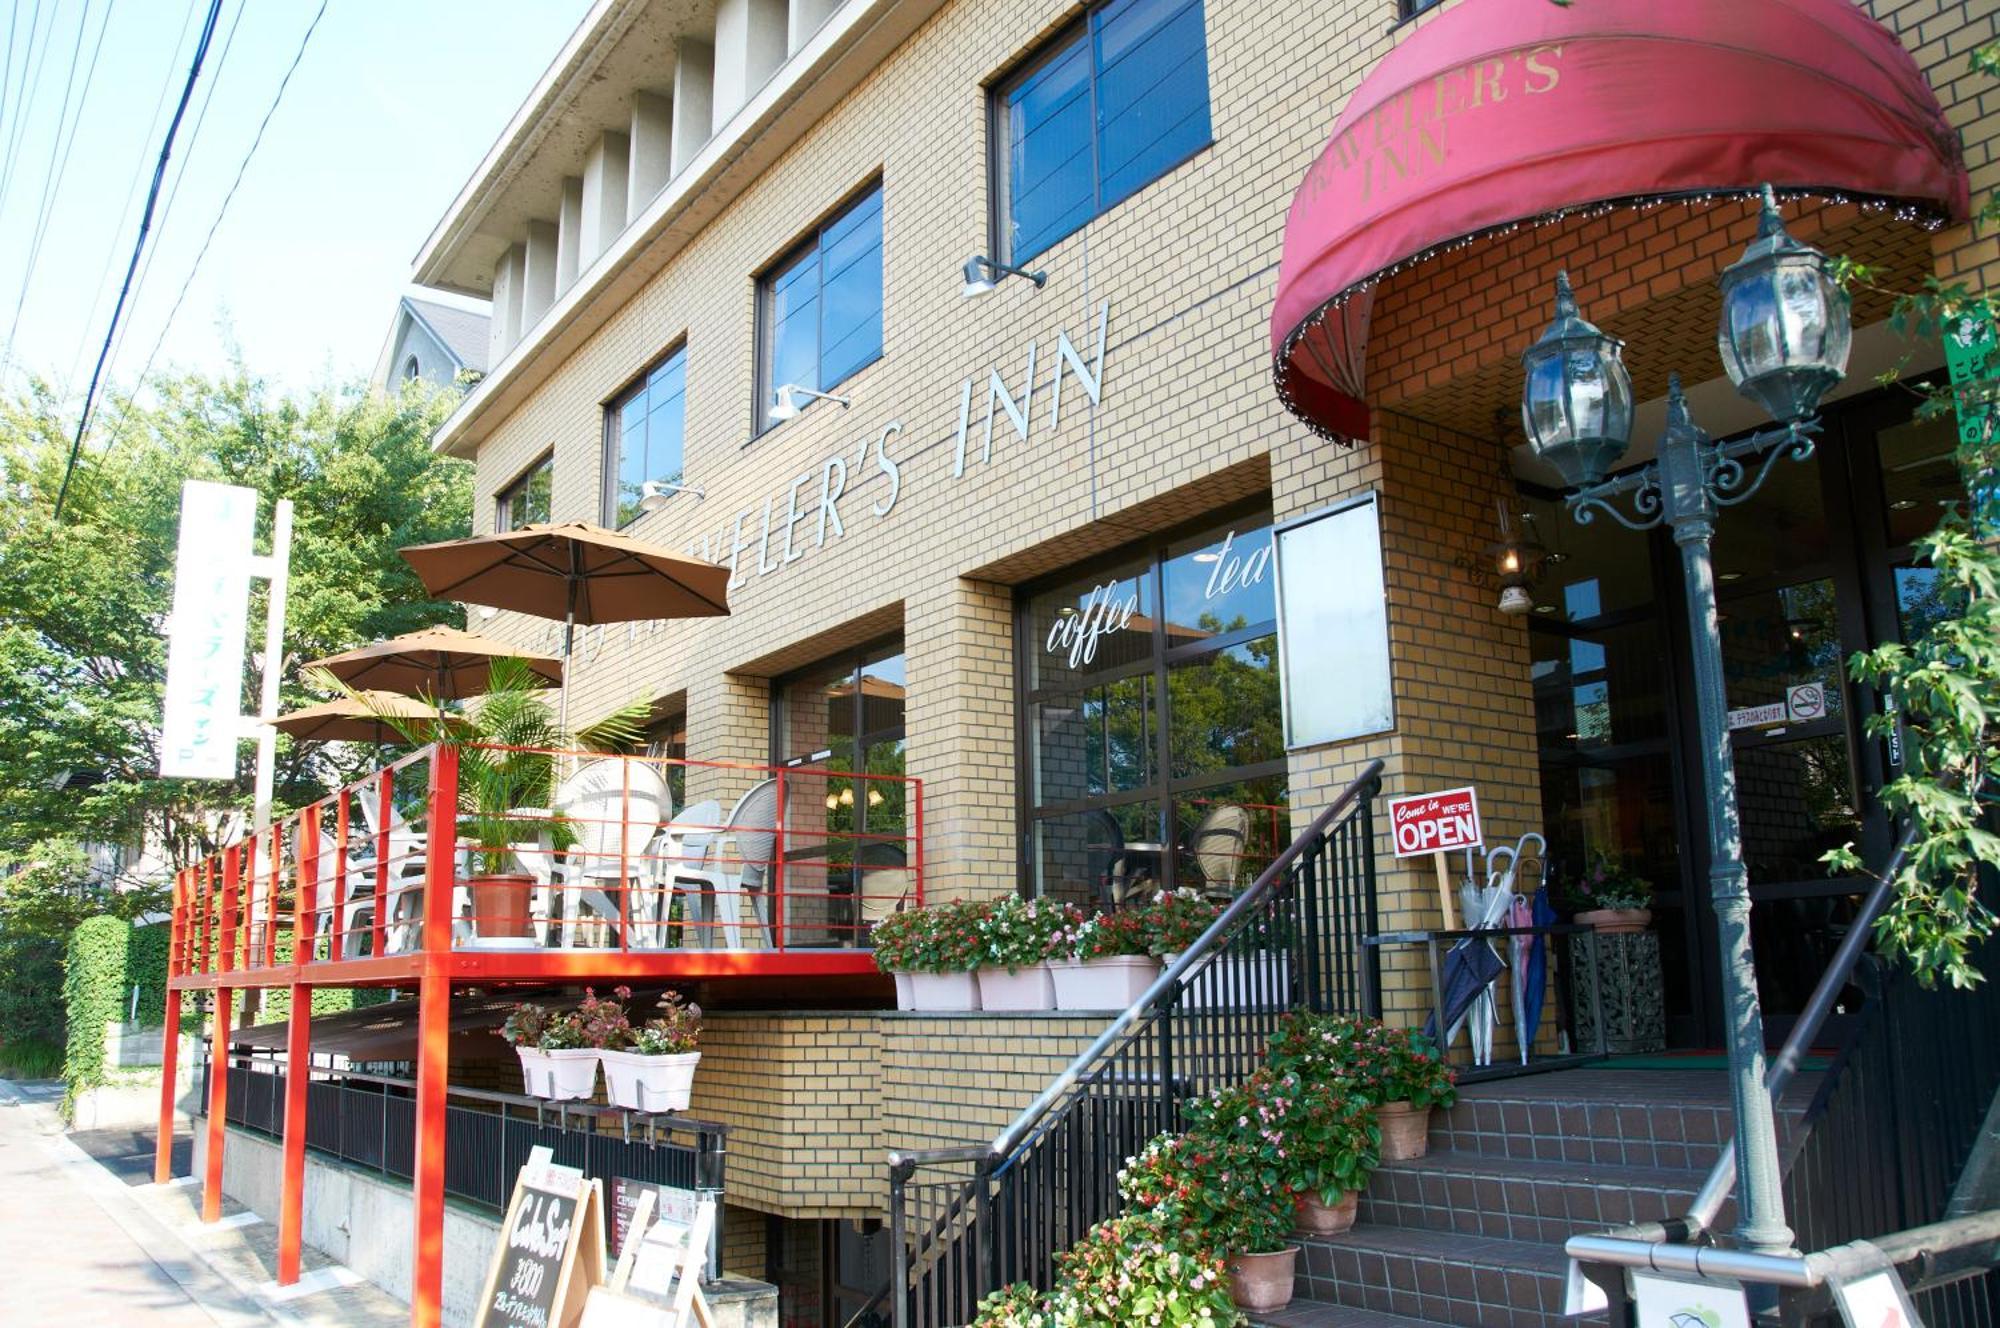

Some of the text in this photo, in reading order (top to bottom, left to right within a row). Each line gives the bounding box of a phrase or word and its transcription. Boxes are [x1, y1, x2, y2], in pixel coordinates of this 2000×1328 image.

[1361, 118, 1448, 205] INN
[954, 299, 1108, 478] INN
[1047, 530, 1273, 669] coffee tea
[1397, 800, 1440, 823] Come in
[1398, 814, 1476, 851] OPEN
[1442, 802, 1471, 814] WE'RE
